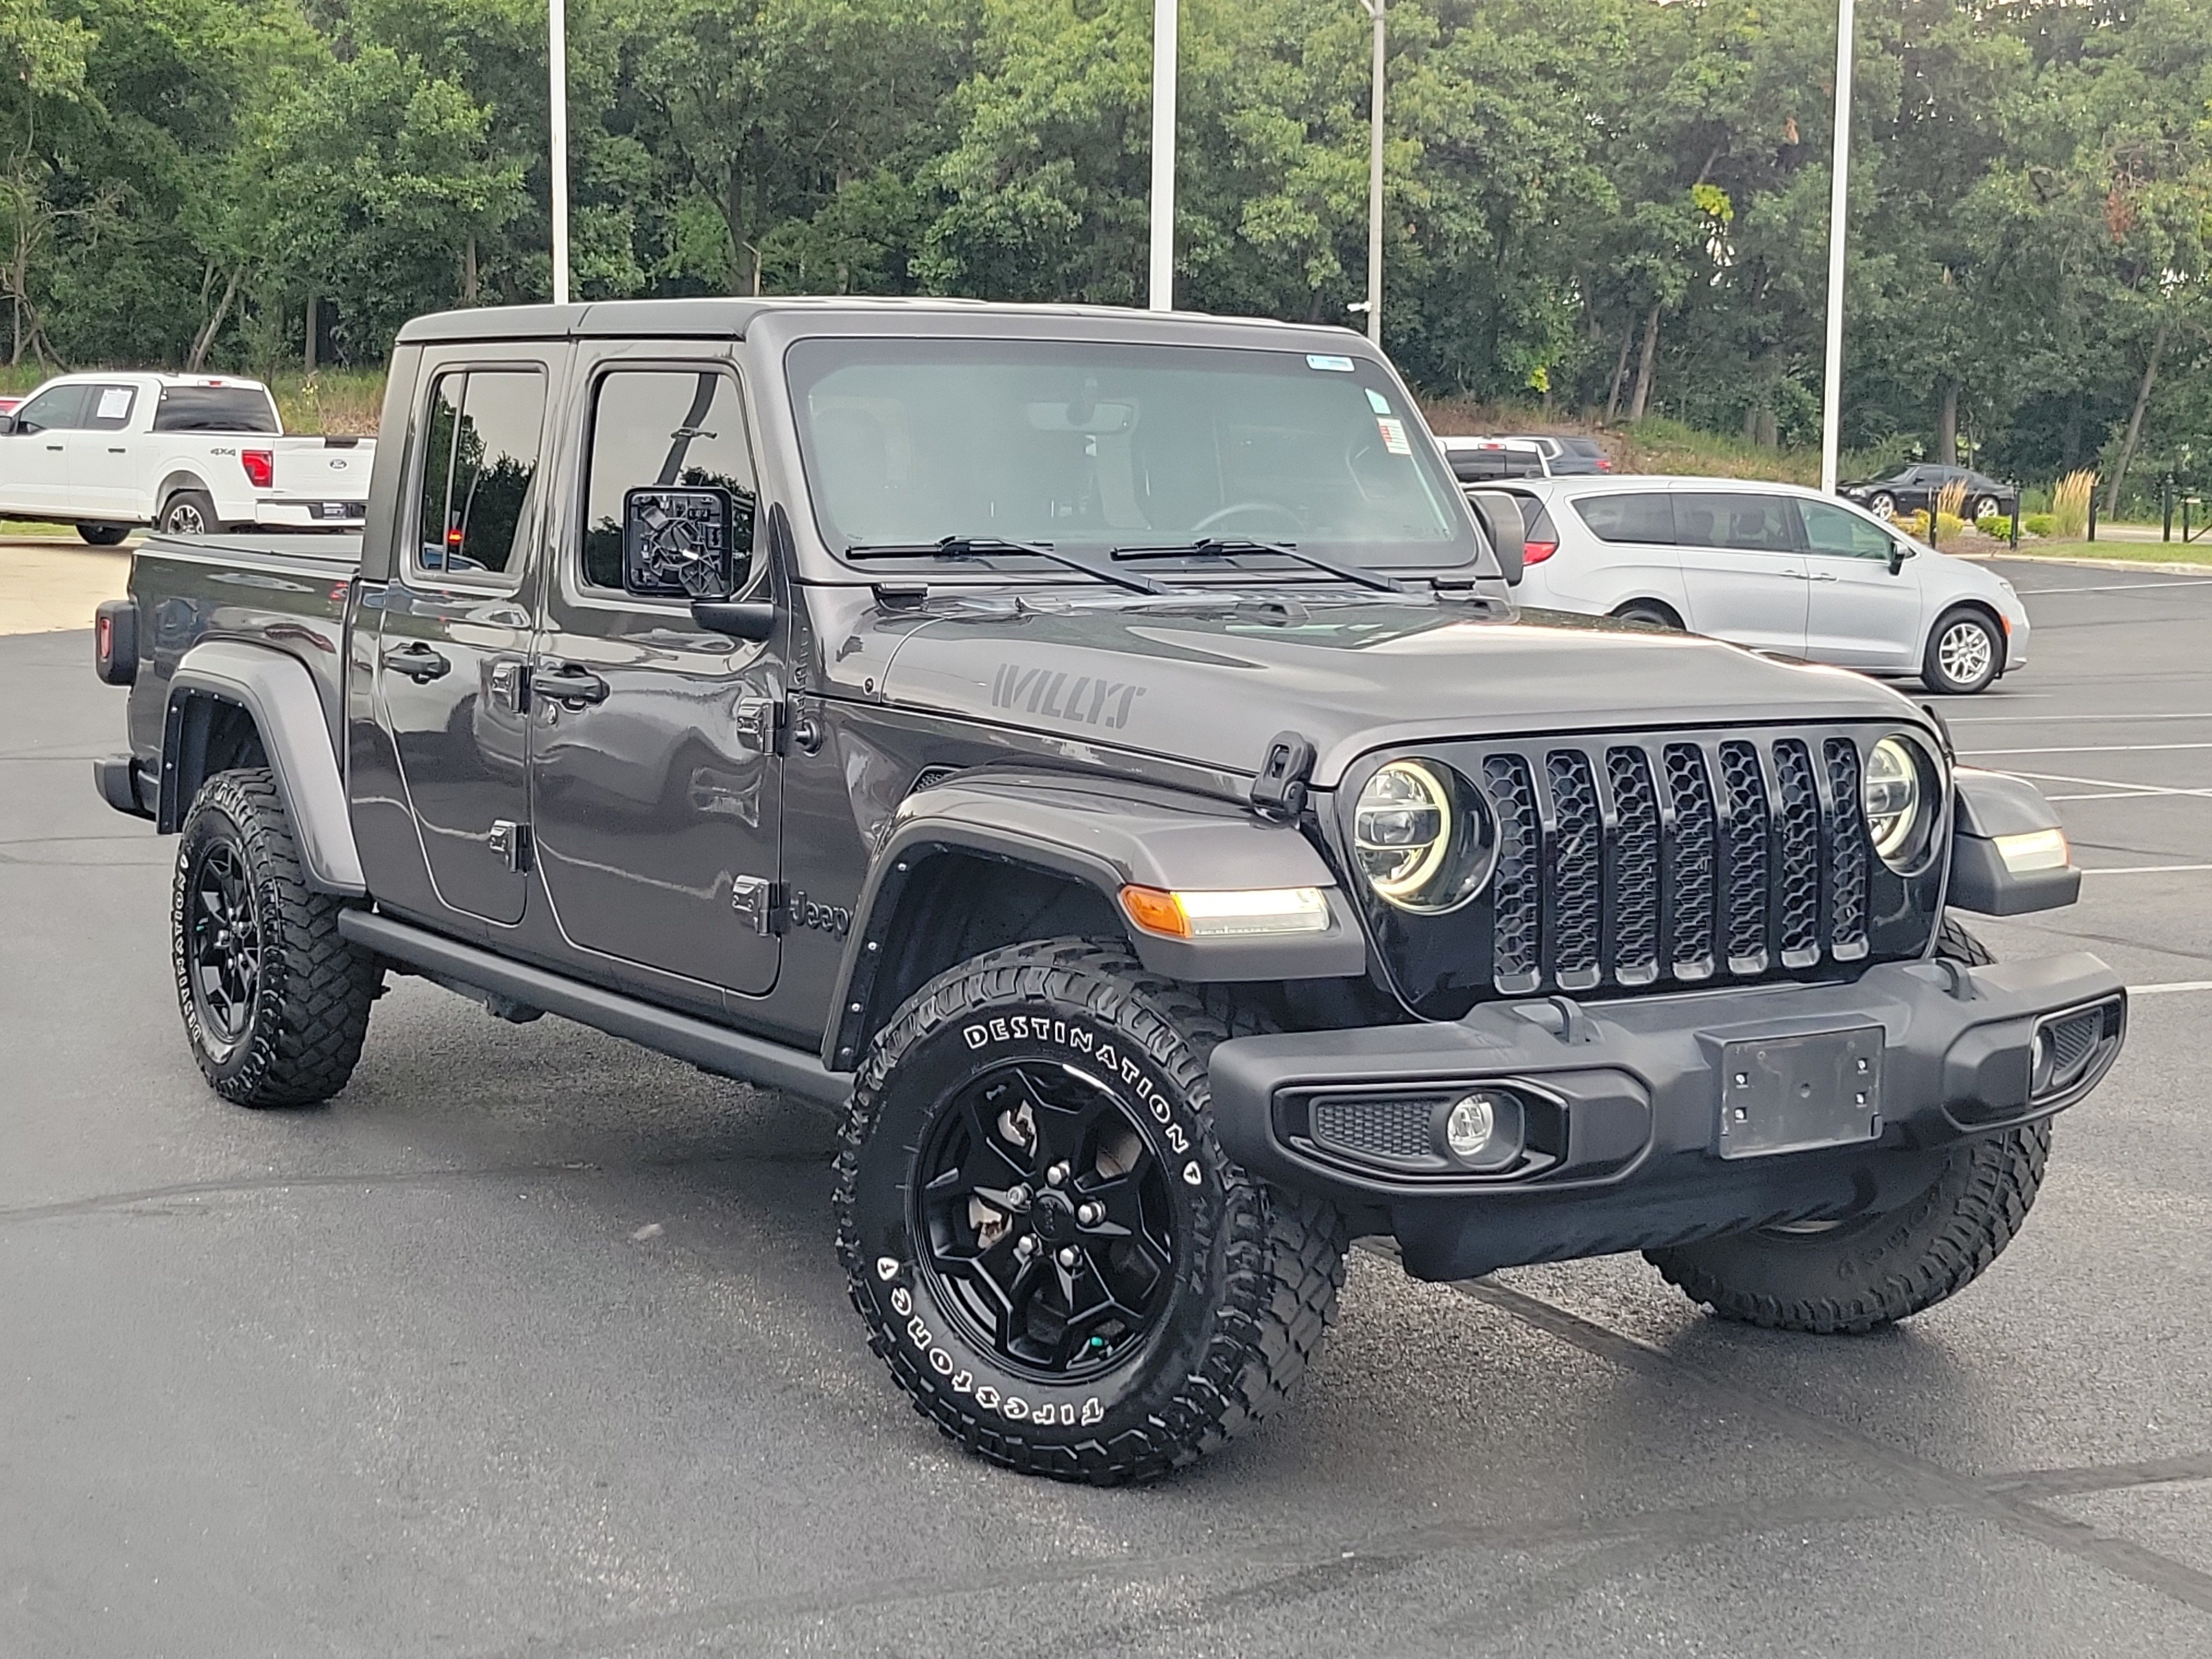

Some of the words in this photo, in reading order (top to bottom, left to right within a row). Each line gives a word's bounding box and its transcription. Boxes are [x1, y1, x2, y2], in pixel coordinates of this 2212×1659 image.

[992, 663, 1147, 729] WILLYS
[792, 890, 850, 941] Jeep
[963, 1016, 1190, 1153] DESTINATION
[891, 1287, 1104, 1426] Firestone
